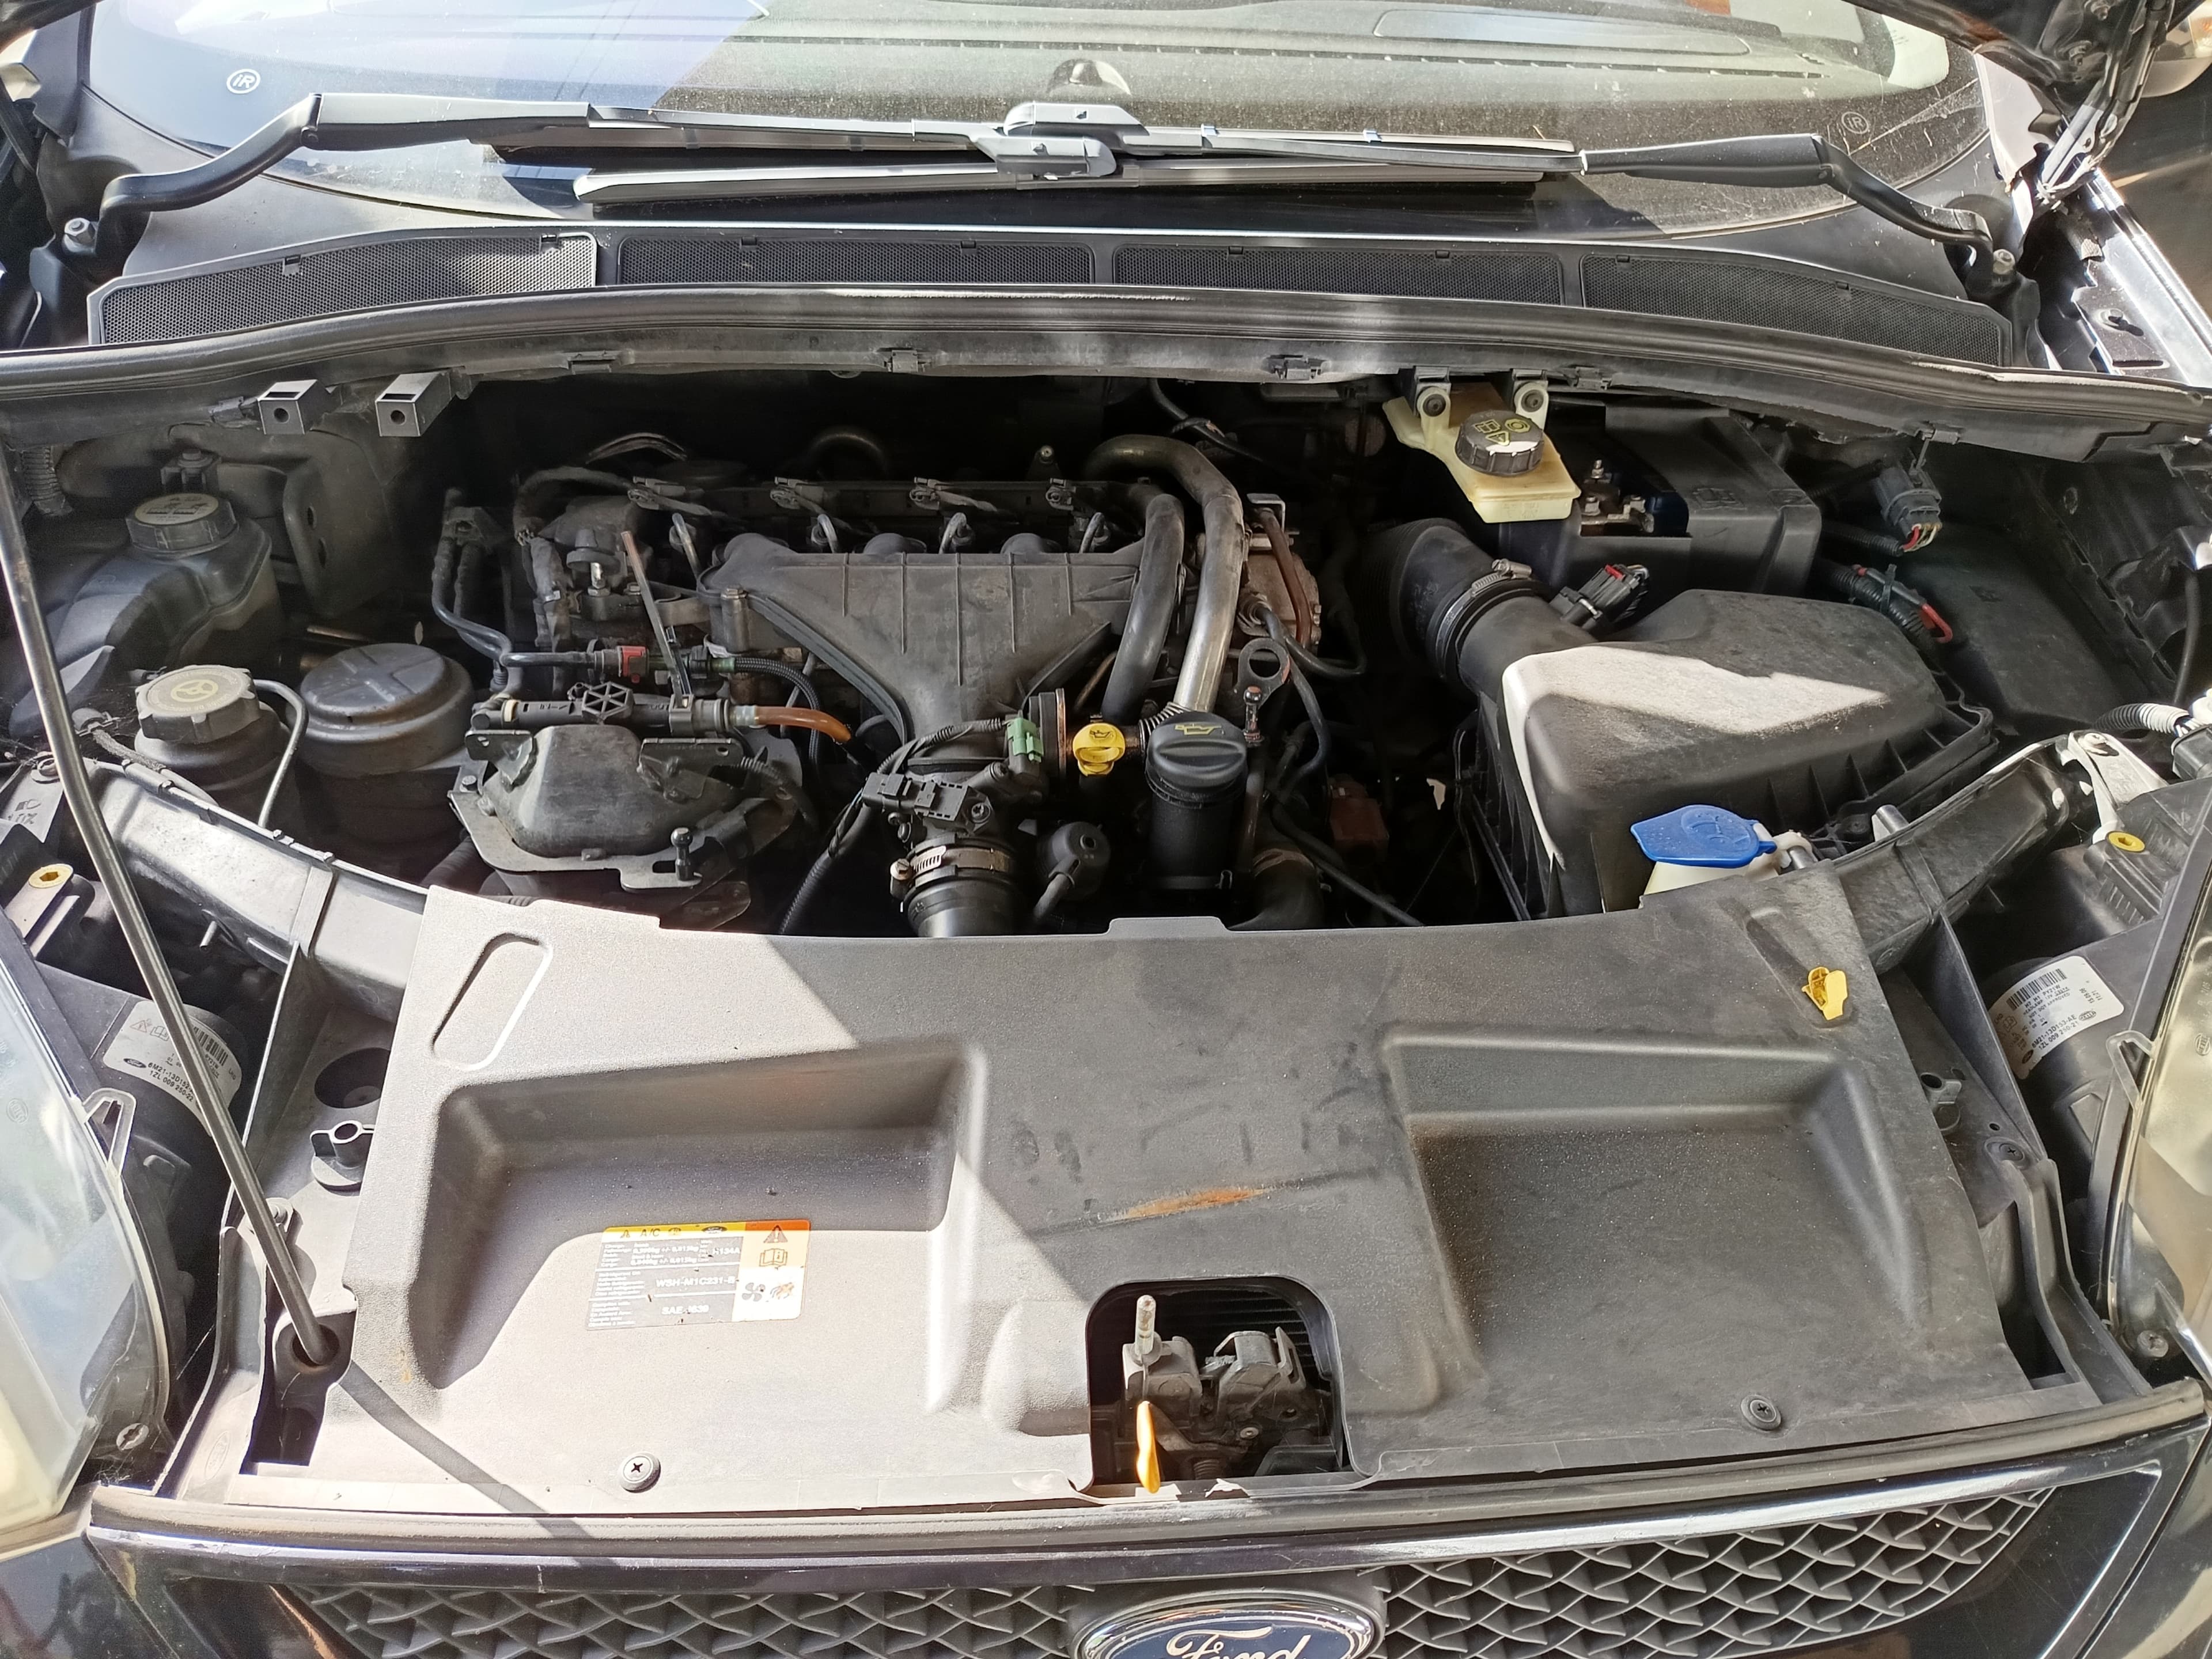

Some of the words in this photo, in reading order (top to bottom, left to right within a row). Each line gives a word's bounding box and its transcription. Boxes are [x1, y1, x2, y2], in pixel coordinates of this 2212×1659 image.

[2032, 1014, 2077, 1048] 6M21-13D153-AE
[2038, 1041, 2048, 1050] 1ZL
[2048, 1033, 2059, 1043] 009
[149, 1070, 161, 1080] 1ZL
[162, 1077, 175, 1088] 009
[175, 1084, 194, 1102] 250-22
[640, 1228, 661, 1238] A/C
[662, 1306, 683, 1315] SAE
